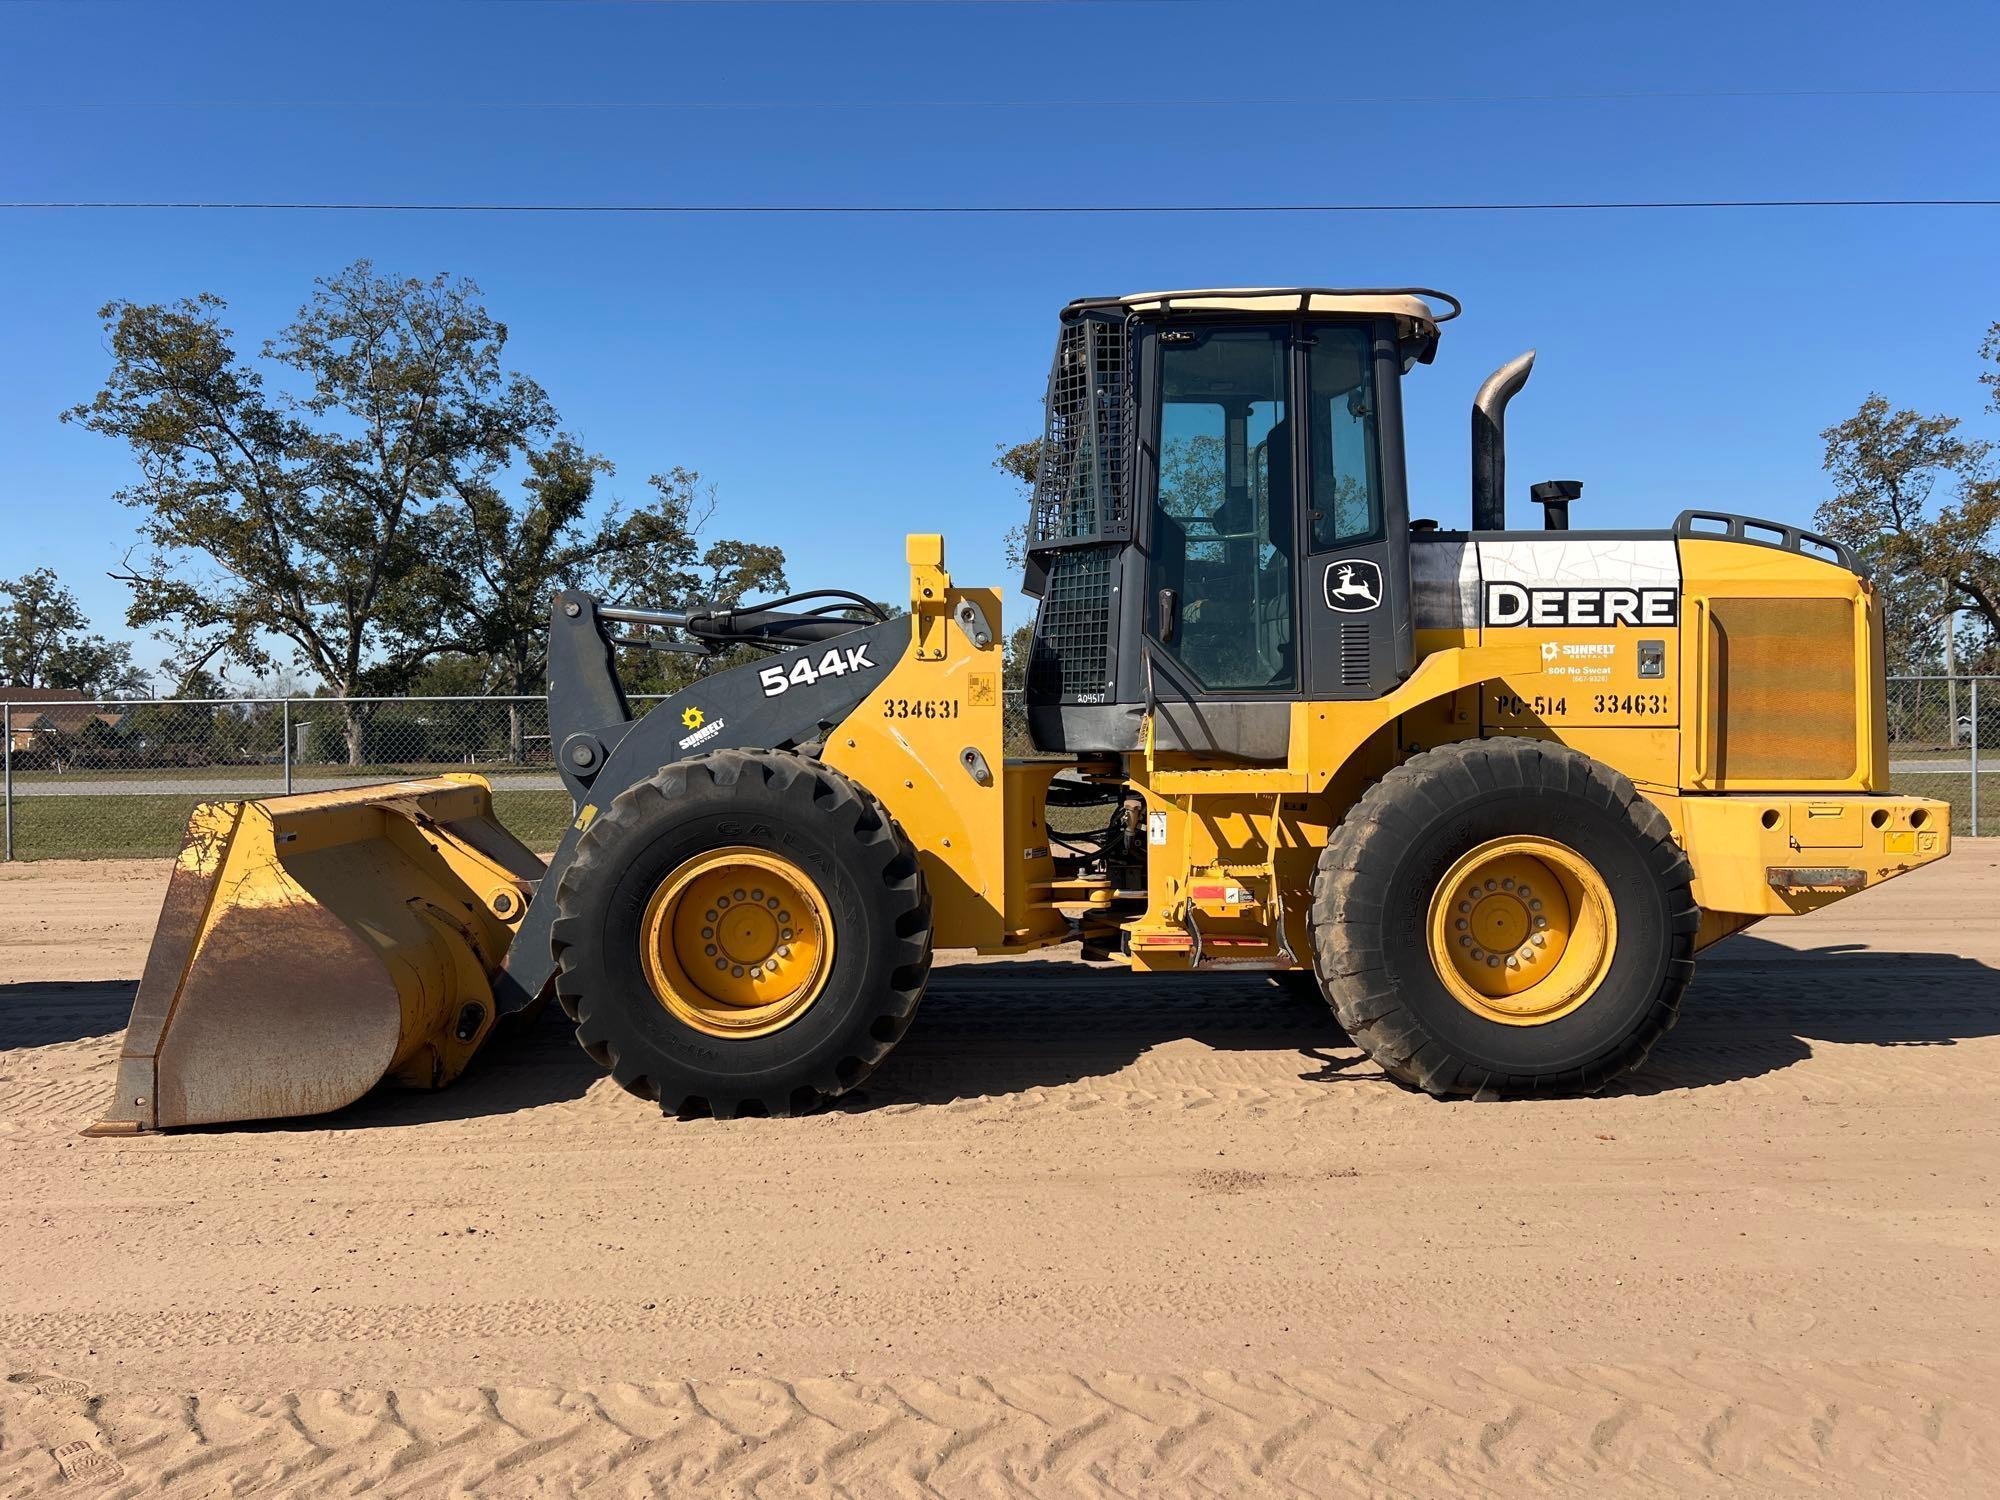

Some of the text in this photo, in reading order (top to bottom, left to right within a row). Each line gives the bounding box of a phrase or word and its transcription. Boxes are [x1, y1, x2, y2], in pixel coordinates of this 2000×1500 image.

[1486, 581, 1677, 627] DEERE
[758, 642, 879, 698] 544K
[1567, 666, 1581, 675] No
[1582, 666, 1611, 675] Sweat
[1077, 693, 1105, 704] 204517
[1496, 695, 1567, 715] PC-514
[883, 699, 958, 719] 334631
[678, 717, 725, 750] SUNBELT
